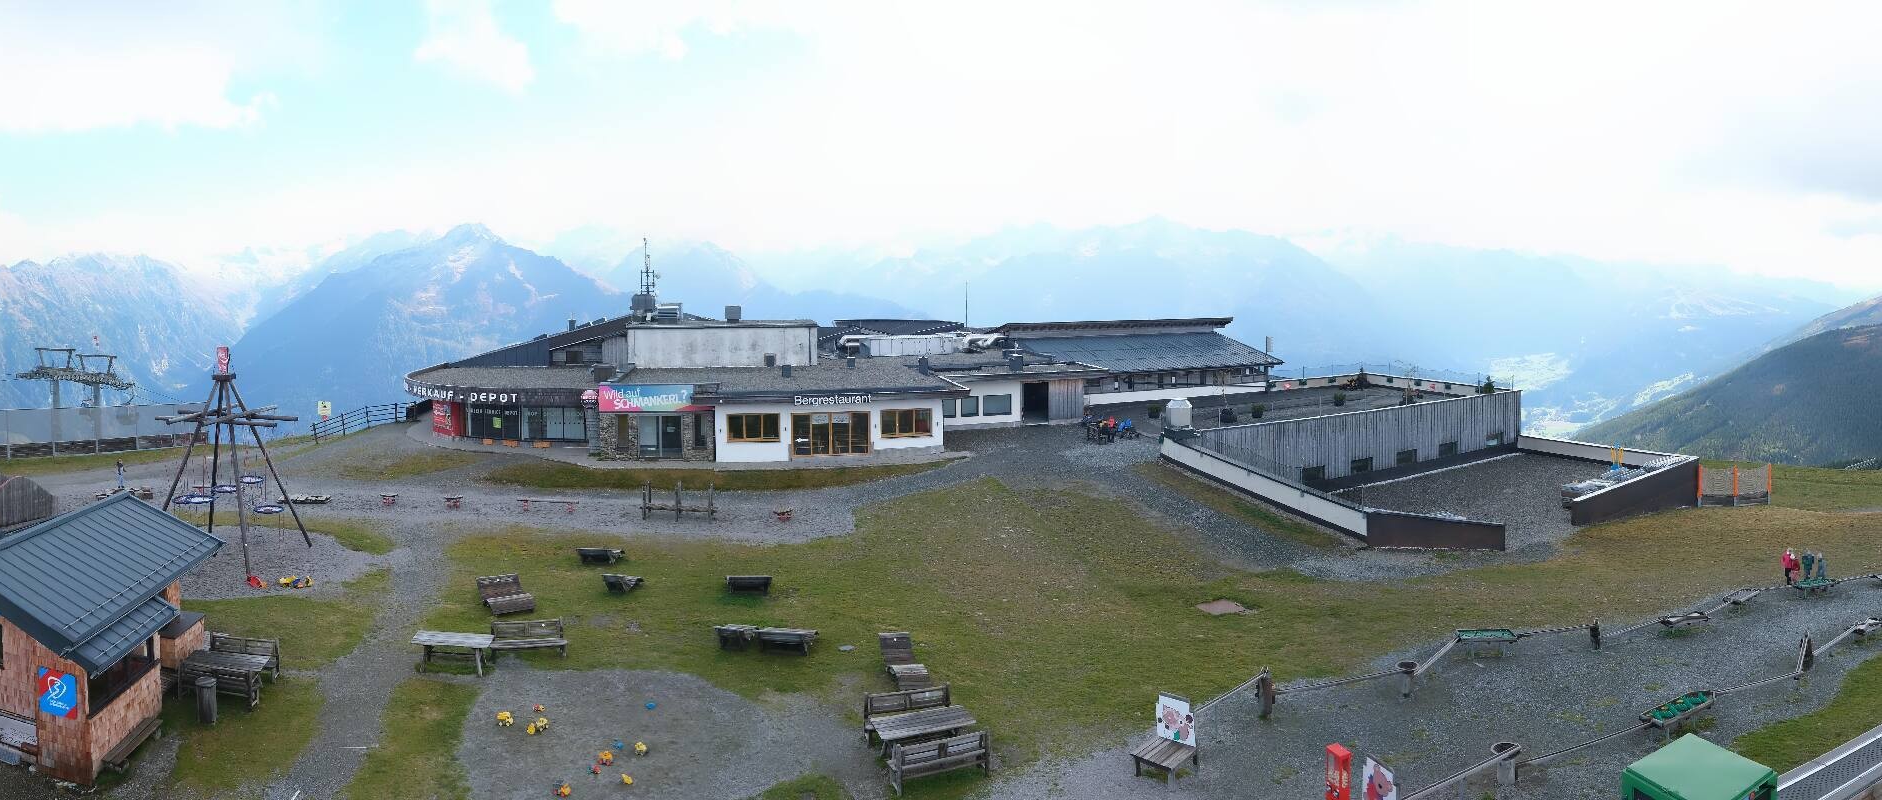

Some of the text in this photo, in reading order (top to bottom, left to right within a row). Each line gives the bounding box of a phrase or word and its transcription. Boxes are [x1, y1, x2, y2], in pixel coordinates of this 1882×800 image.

[470, 392, 518, 403] DEPOT
[603, 389, 624, 399] Wild
[625, 387, 641, 399] auf
[794, 394, 872, 407] Bergrestaurant
